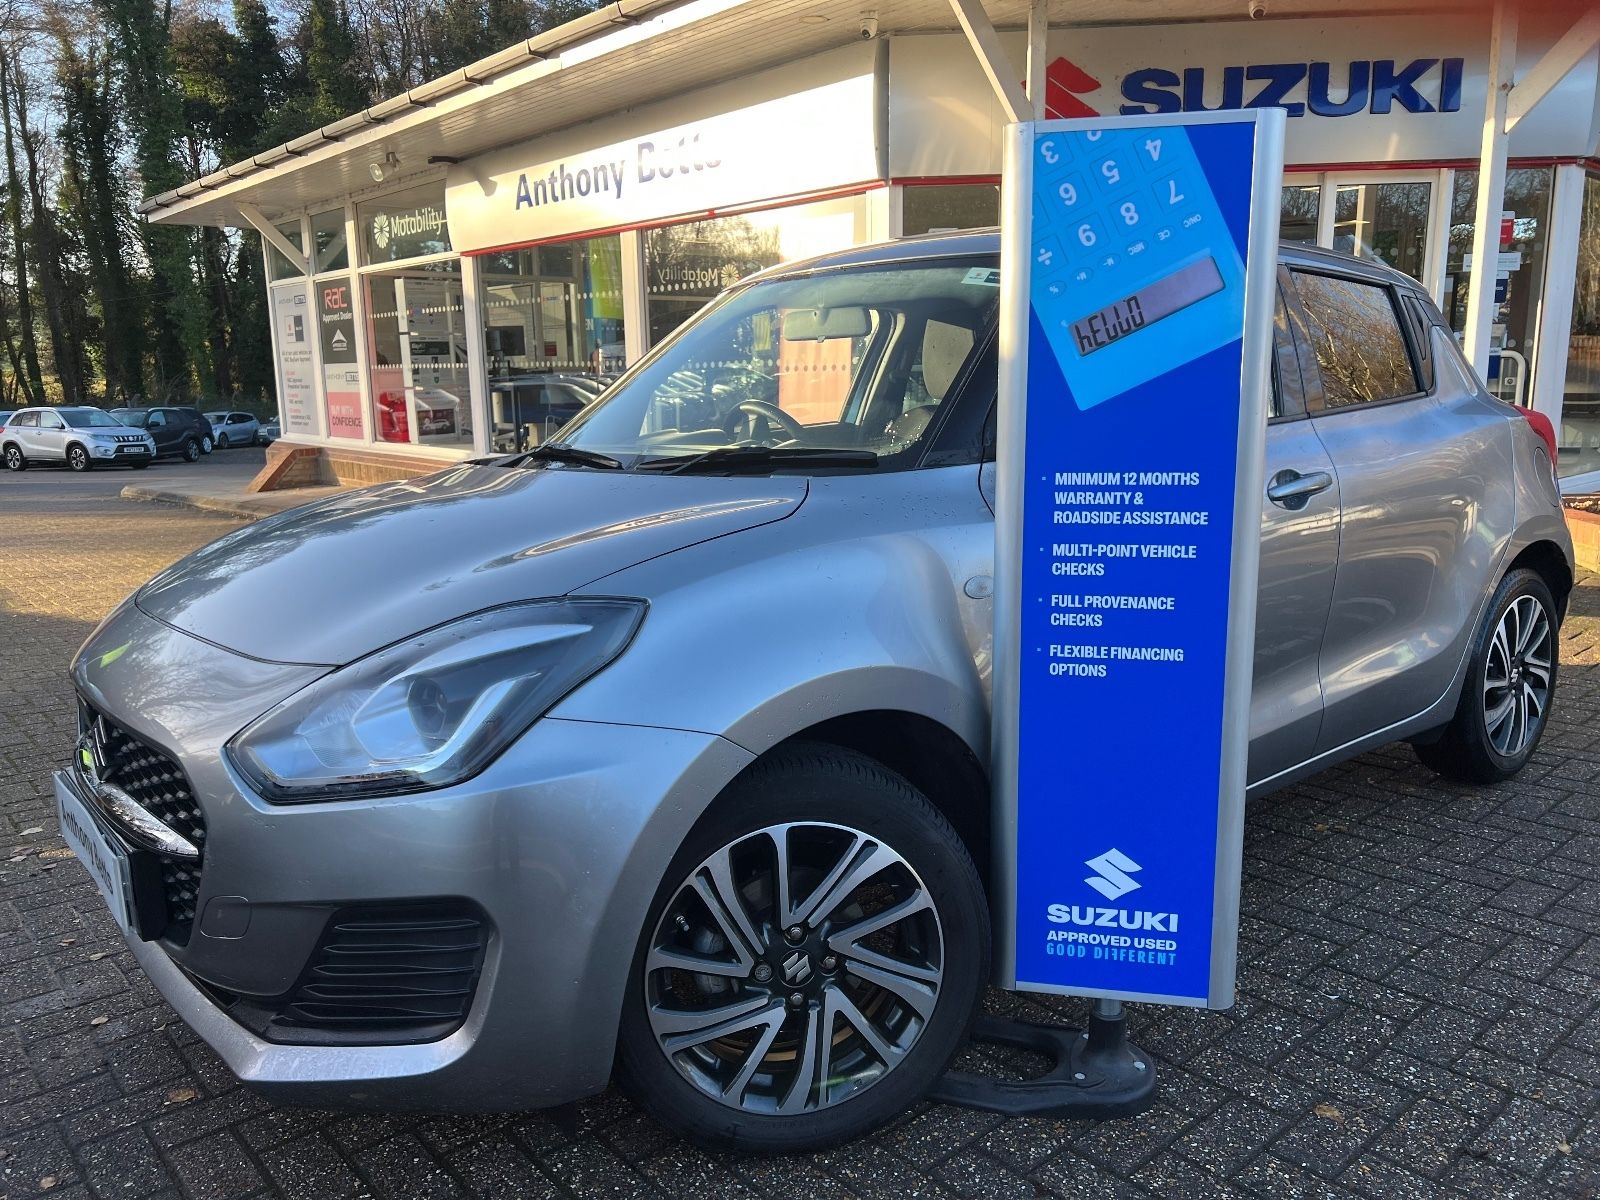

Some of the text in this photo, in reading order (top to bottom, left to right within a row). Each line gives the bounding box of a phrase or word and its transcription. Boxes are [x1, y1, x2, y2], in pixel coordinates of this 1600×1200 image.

[1119, 58, 1464, 117] SUZUKI
[1041, 141, 1059, 164] 3
[1145, 138, 1162, 162] 4
[1102, 160, 1121, 184] 5
[515, 160, 625, 210] Anthony
[1169, 180, 1185, 205] 7
[391, 207, 442, 238] Motability
[1120, 202, 1139, 225] 8
[332, 416, 362, 427] CONFIDENCE
[1055, 472, 1200, 486] MINIMUM 12 MONTHS
[1055, 491, 1144, 505] WARRANTY &
[1053, 511, 1208, 525] ROADSIDE ASSISTANCE
[1052, 543, 1197, 558] MULTI-POINT VEHICLE
[1052, 562, 1105, 576] CHECKS
[1051, 594, 1175, 610] FULL PROVENANCE
[1050, 613, 1102, 626] CHECKS
[1049, 644, 1184, 662] FLEXIBLE FINANCING
[1049, 662, 1107, 677] OPTIONS
[61, 799, 96, 866] Anthony
[1047, 903, 1178, 932] SUZUKI
[1047, 930, 1177, 951] APPROVED USED
[1046, 942, 1177, 966] GOOD DIFFERENT
